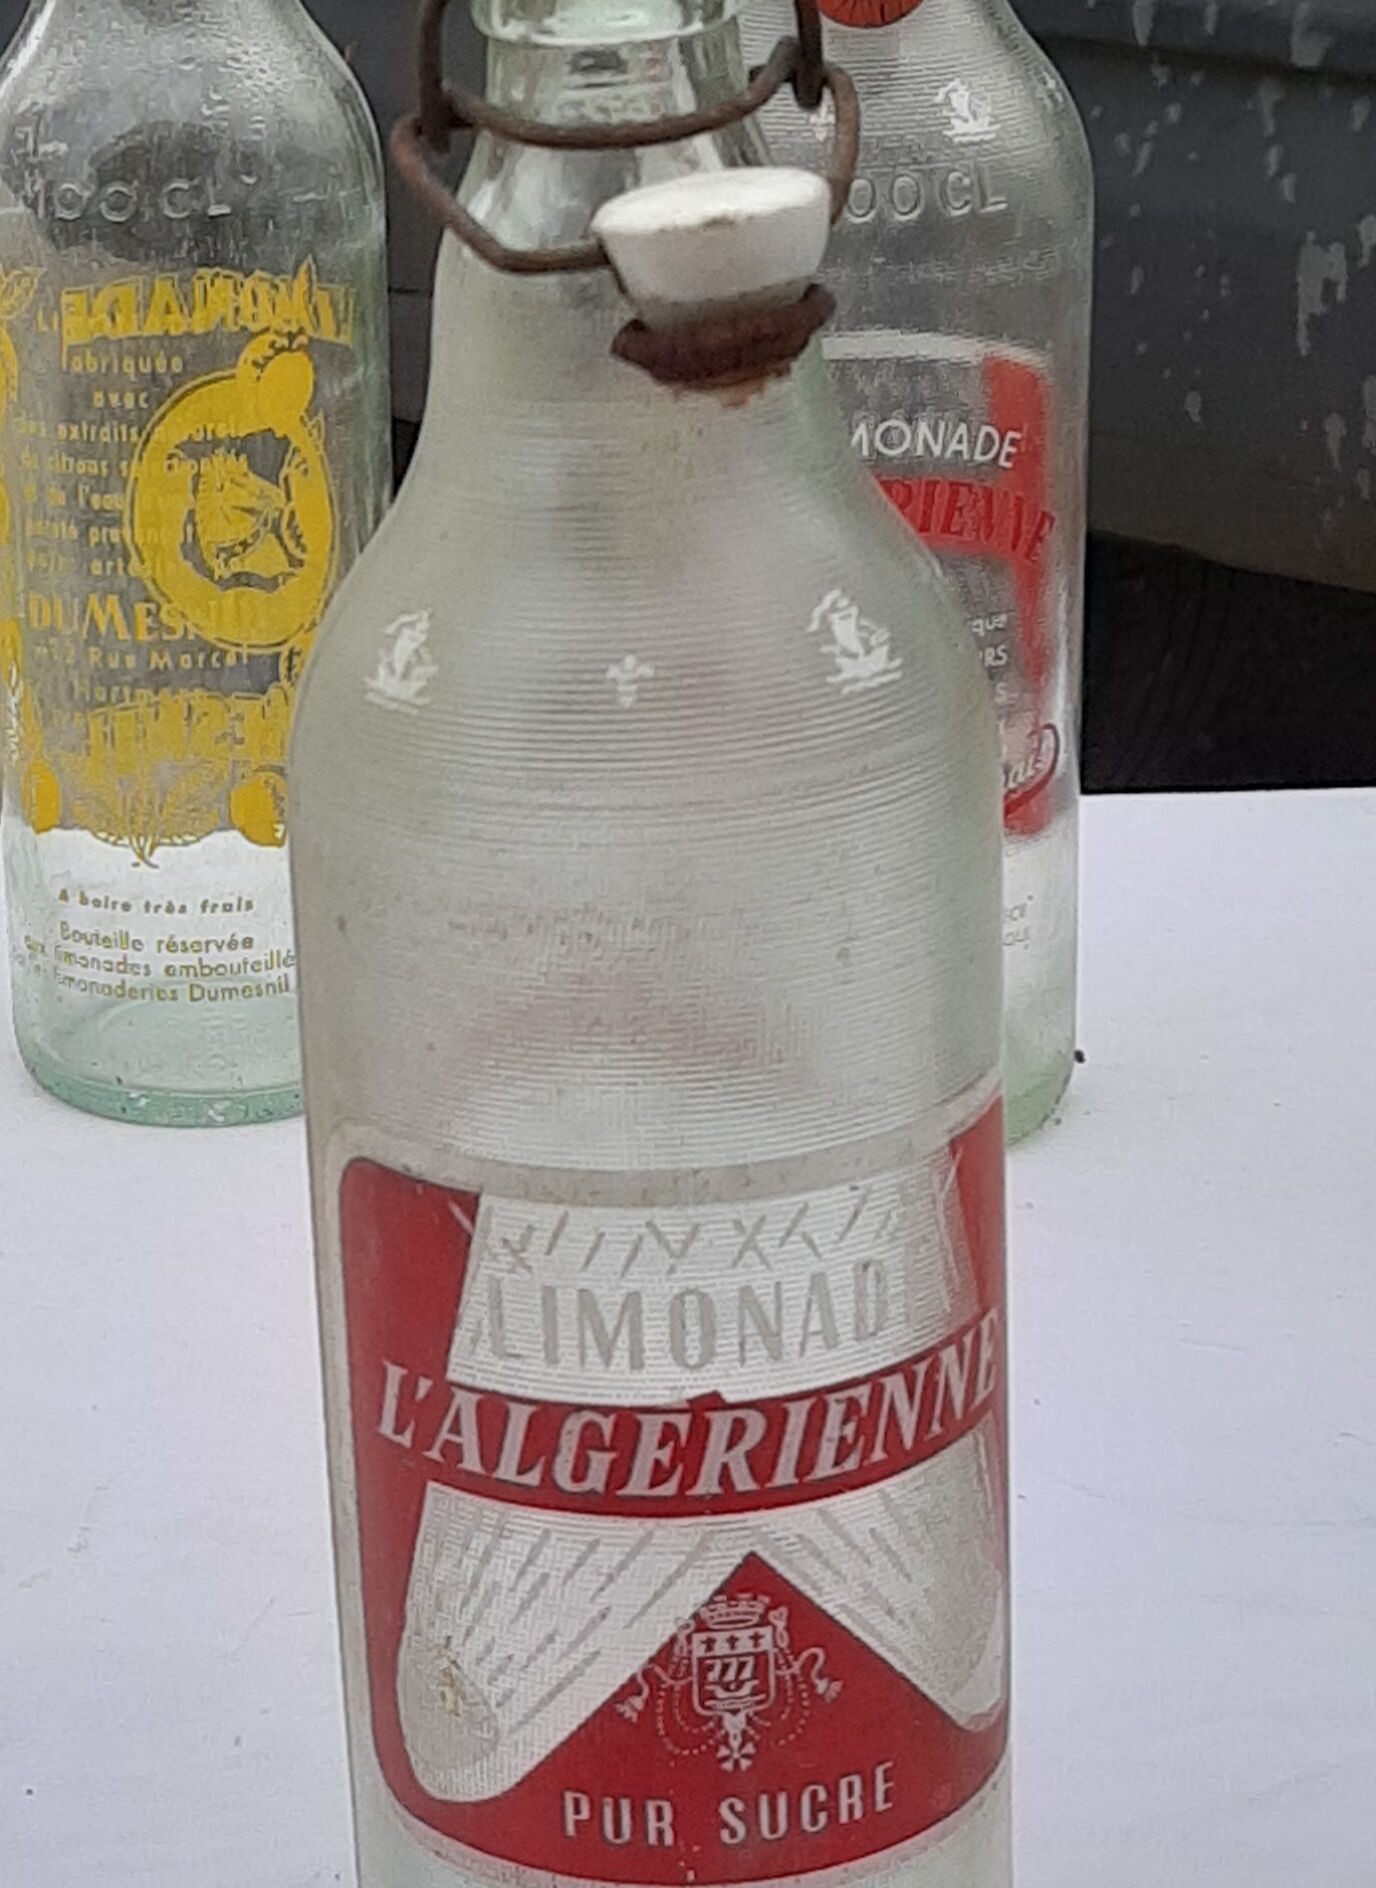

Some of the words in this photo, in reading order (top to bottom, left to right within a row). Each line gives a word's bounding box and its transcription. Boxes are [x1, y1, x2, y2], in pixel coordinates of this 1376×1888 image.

[846, 175, 923, 225] 00
[937, 167, 1009, 217] CL
[850, 419, 1024, 469] MONADE
[78, 889, 133, 913] boire
[143, 899, 188, 915] très
[199, 895, 255, 914] frais
[59, 920, 146, 953] Bouteille
[155, 931, 257, 955] réservée
[163, 948, 298, 979] embouteillé
[187, 973, 292, 1004] Dumesnil
[562, 1789, 676, 1848] PUR
[719, 1761, 896, 1845] SUCRE
